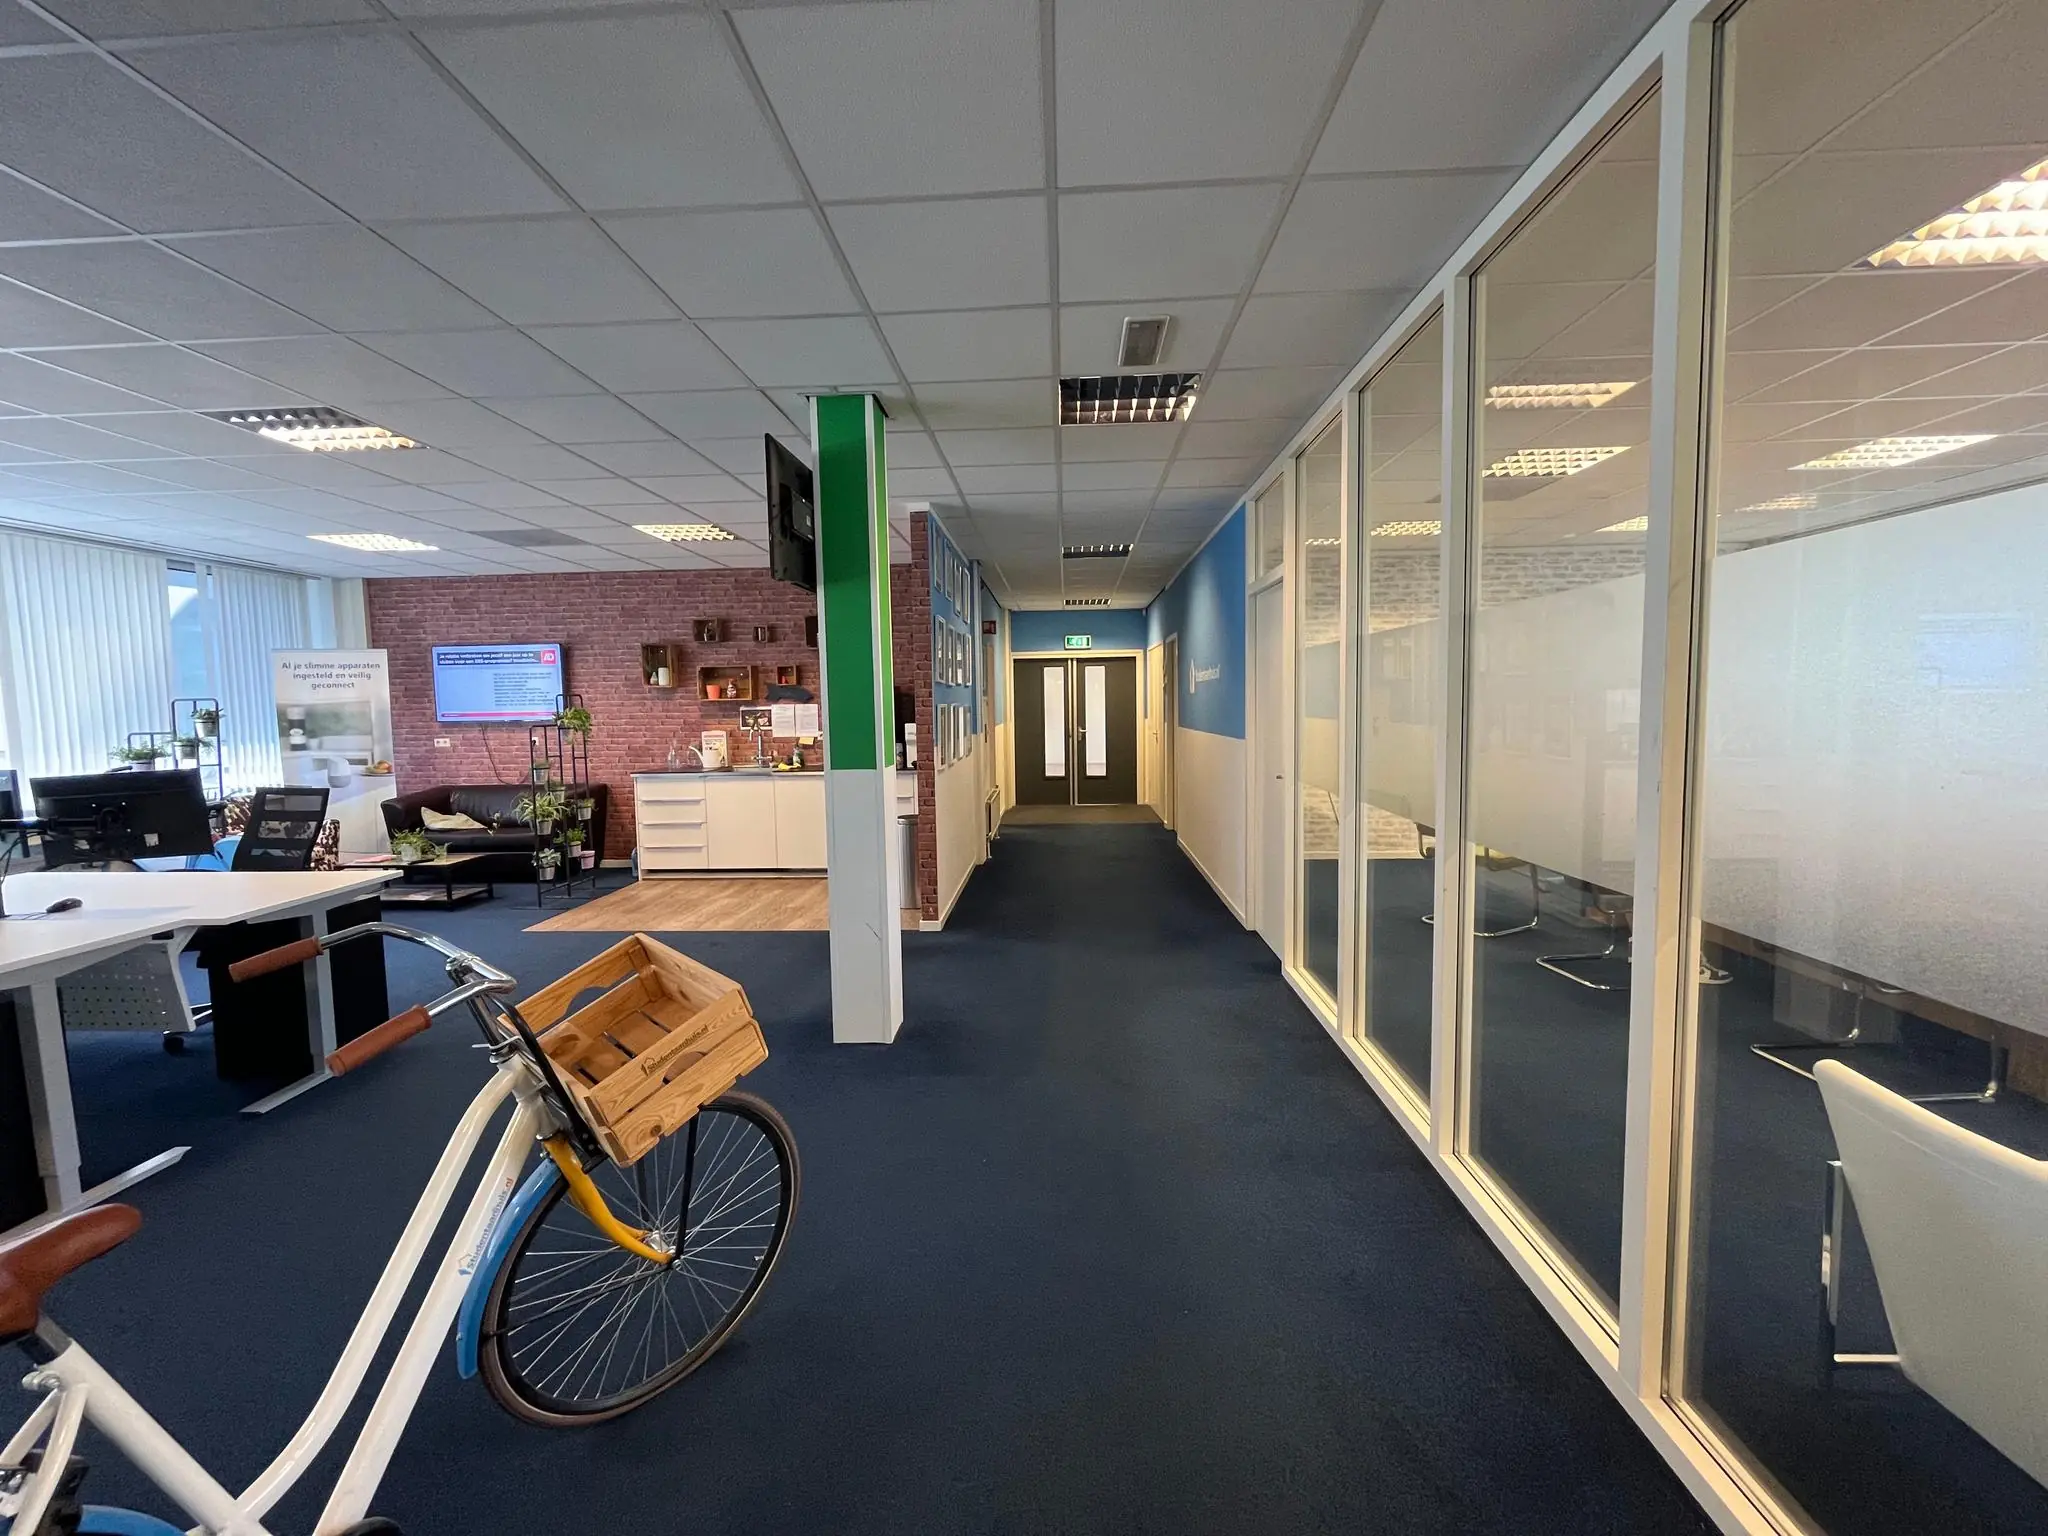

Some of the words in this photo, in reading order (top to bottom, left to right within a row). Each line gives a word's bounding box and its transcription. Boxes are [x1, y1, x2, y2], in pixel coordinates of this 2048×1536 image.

[282, 661, 291, 669] Al
[294, 662, 302, 671] je
[304, 661, 335, 669] slimme
[337, 662, 380, 671] apparaten
[293, 671, 333, 681] ingesteld
[348, 671, 371, 681] veilig
[311, 682, 355, 691] geconnect
